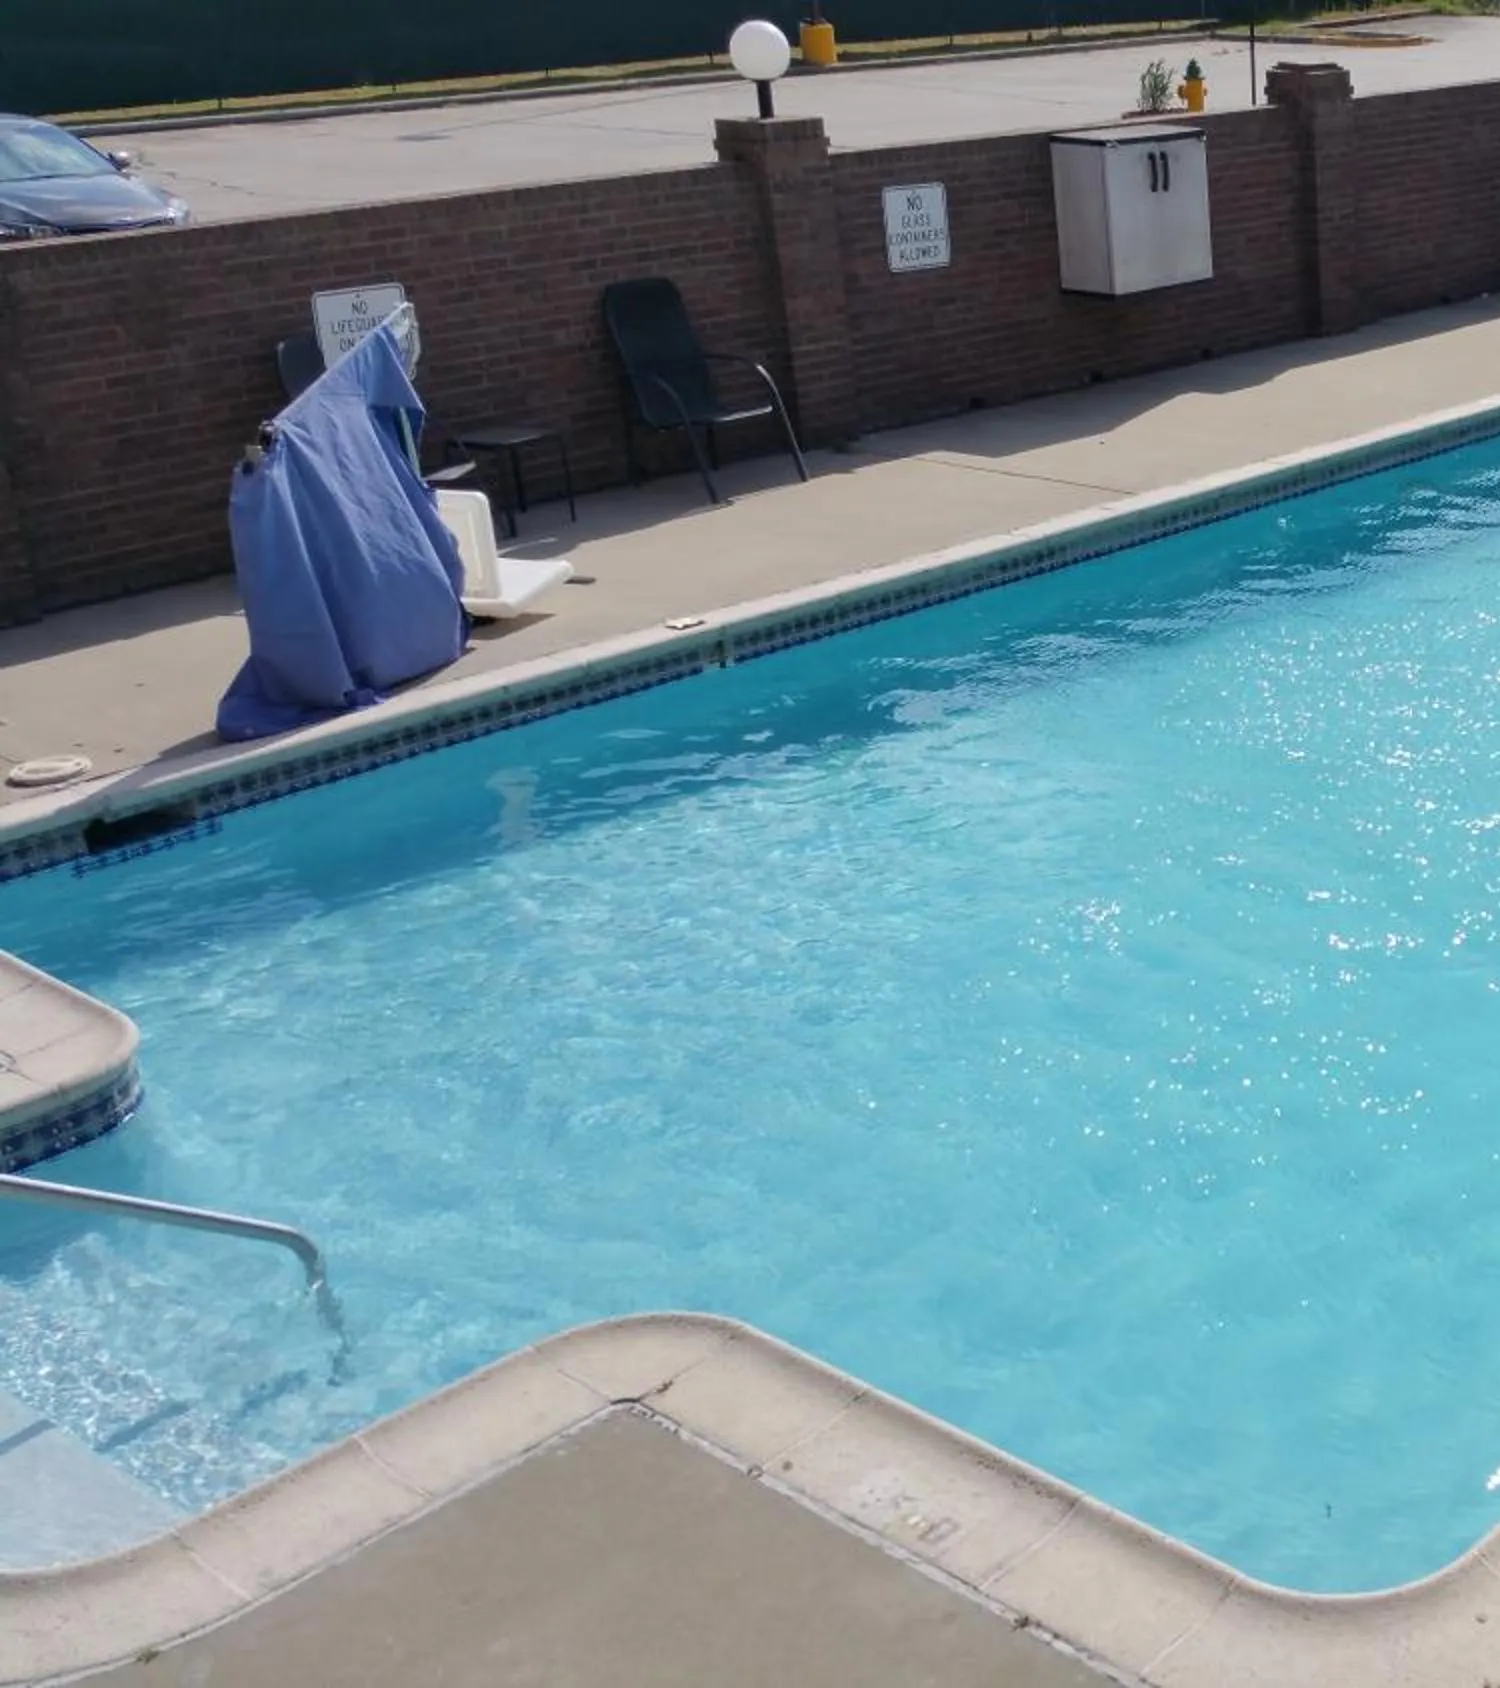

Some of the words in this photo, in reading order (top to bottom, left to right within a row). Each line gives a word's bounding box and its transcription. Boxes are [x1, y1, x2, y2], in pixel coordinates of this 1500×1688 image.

[907, 195, 922, 211] NO
[899, 246, 940, 261] ALLOWED
[352, 300, 368, 314] NO
